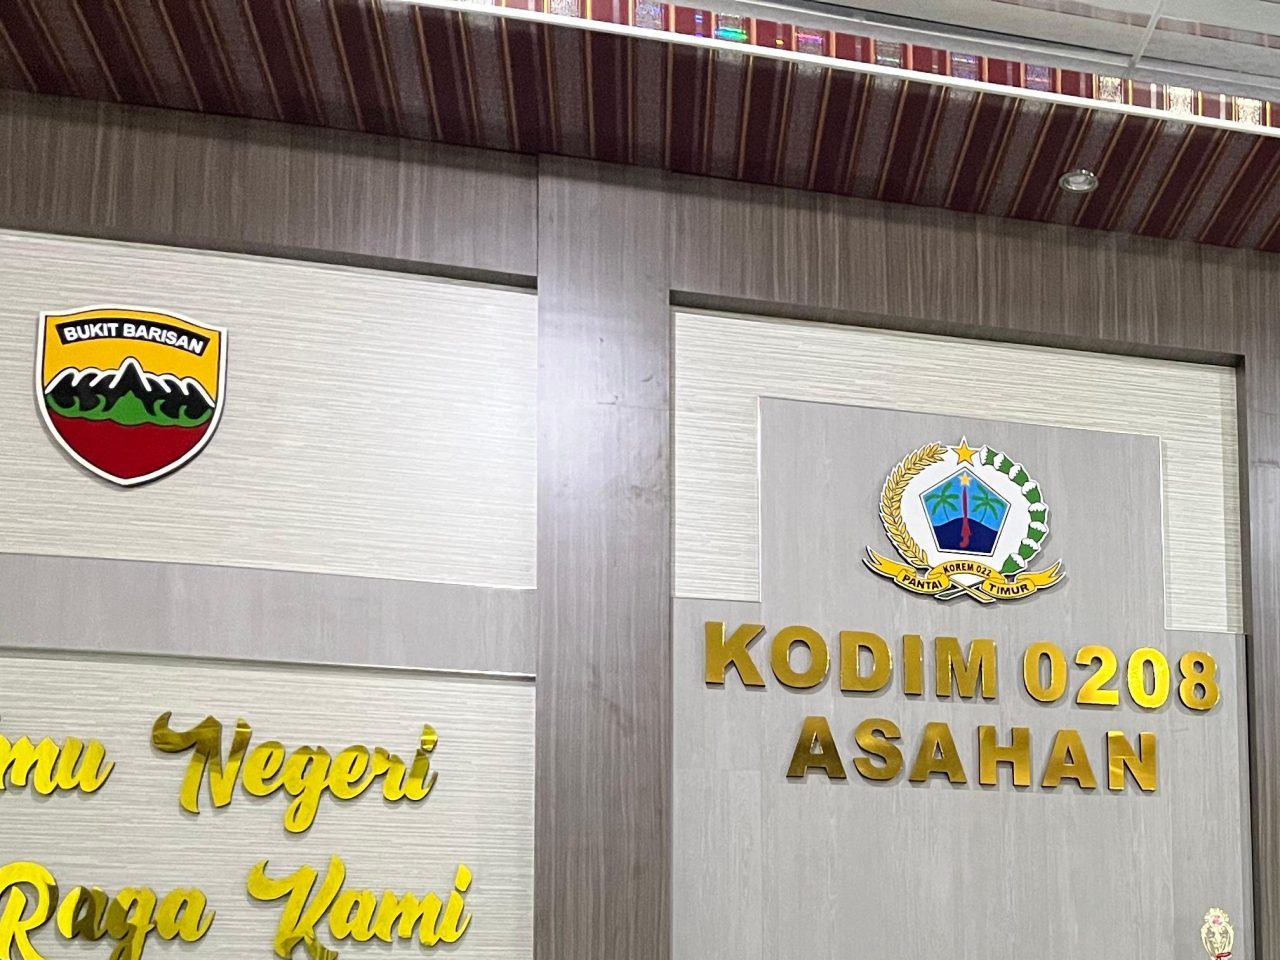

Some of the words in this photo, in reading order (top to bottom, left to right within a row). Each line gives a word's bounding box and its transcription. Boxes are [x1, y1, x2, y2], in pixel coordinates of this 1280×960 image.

[63, 323, 119, 341] BUKIT
[122, 323, 204, 354] BARISAN
[901, 574, 943, 590] PANTAI
[942, 563, 975, 574] KOREM
[976, 565, 992, 577] 022
[988, 582, 1030, 596] TIMUR
[705, 620, 997, 700] KODIM
[1022, 640, 1221, 711] 0208
[785, 715, 1159, 792] ASAHAN
[150, 710, 440, 834] Negeri
